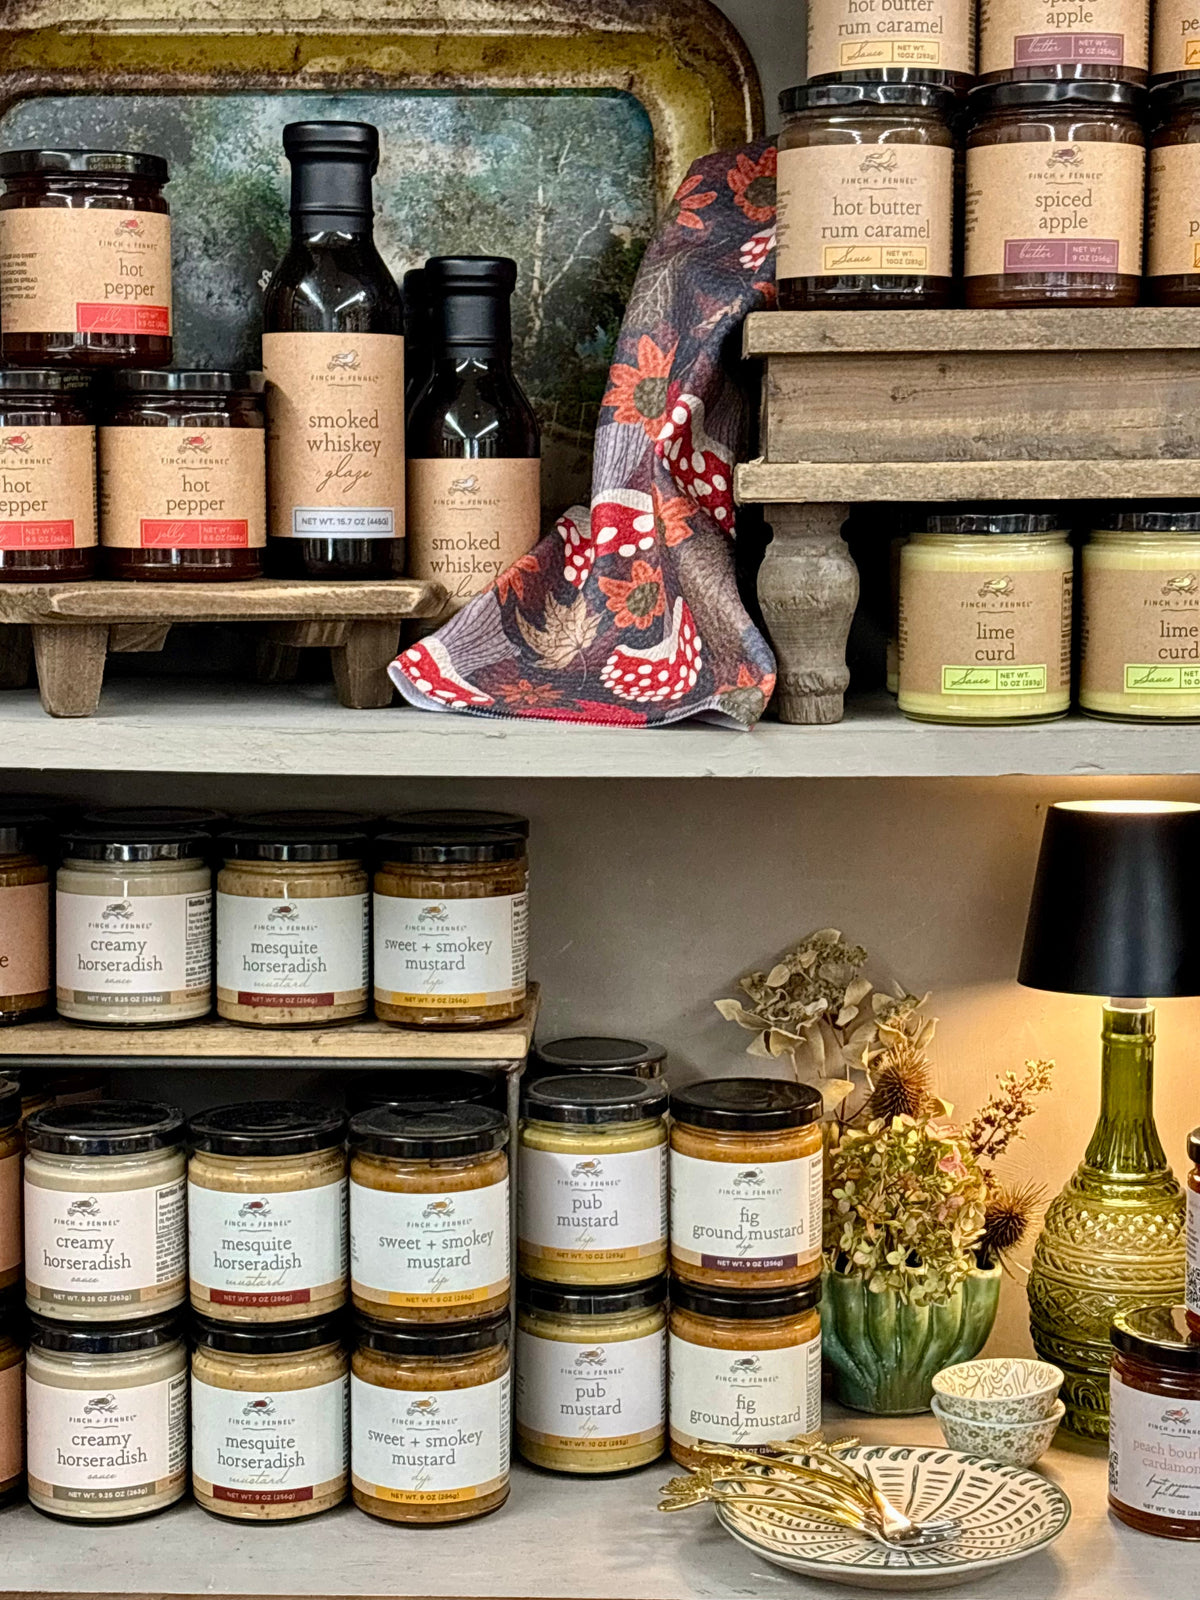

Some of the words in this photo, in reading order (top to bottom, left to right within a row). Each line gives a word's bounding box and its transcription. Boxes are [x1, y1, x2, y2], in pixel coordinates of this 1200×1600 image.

[848, 0, 875, 13] hot
[838, 21, 871, 36] rum
[877, 16, 944, 34] caramel
[1046, 6, 1093, 28] apple
[841, 177, 869, 185] FINCH
[832, 195, 862, 216] hot
[869, 195, 922, 215] butter
[1035, 189, 1093, 211] spiced
[821, 226, 858, 239] rum
[864, 219, 930, 239] caramel
[1039, 210, 1088, 233] apple
[119, 258, 144, 277] hot
[104, 282, 155, 300] pepper
[308, 409, 380, 429] smoked
[306, 432, 382, 457] whiskey
[161, 457, 187, 465] FINCH
[315, 453, 372, 493] glaze
[2, 475, 32, 493] hot
[182, 474, 210, 492] hot
[0, 499, 48, 517] epper
[166, 499, 225, 516] pepper
[301, 517, 317, 526] NET
[319, 517, 335, 526] WT.
[337, 517, 352, 525] 15.7
[355, 517, 366, 525] OZ
[432, 531, 500, 550] smoked
[430, 554, 503, 577] whiskey
[976, 622, 1015, 640] lime
[1160, 620, 1198, 638] lime
[975, 643, 1016, 661] curd
[1158, 641, 1200, 659] curd
[1017, 671, 1030, 679] WT.
[90, 938, 147, 954] creamy
[251, 941, 318, 958] mesquite
[384, 939, 417, 953] sweet
[422, 943, 431, 951] +
[436, 936, 493, 955] smokey
[77, 954, 162, 972] horseradish
[243, 955, 327, 973] horseradish
[405, 955, 465, 970] mustard
[572, 1193, 602, 1213] pub
[54, 1218, 75, 1226] FINCH
[556, 1210, 619, 1228] mustard
[740, 1207, 760, 1227] fig
[692, 1224, 743, 1241] ground
[748, 1219, 804, 1240] mustard
[56, 1236, 114, 1253] creamy
[221, 1237, 292, 1255] mesquite
[378, 1236, 421, 1250] sweet
[427, 1241, 436, 1250] +
[442, 1229, 494, 1249] smokey
[43, 1249, 131, 1270] horseradish
[213, 1251, 302, 1271] horseradish
[407, 1249, 471, 1269] mustard
[225, 1269, 287, 1287] mustard
[575, 1382, 606, 1401] pub
[560, 1398, 622, 1416] mustard
[736, 1393, 756, 1413] fig
[69, 1416, 92, 1424] FINCH
[689, 1410, 740, 1428] ground
[744, 1406, 801, 1427] mustard
[71, 1433, 132, 1449] creamy
[225, 1435, 296, 1454] mesquite
[368, 1429, 405, 1447] sweet
[410, 1438, 420, 1447] +
[426, 1429, 483, 1448] smokey
[1133, 1439, 1165, 1455] peach
[56, 1447, 148, 1468] horseradish
[217, 1448, 305, 1469] horseradish
[392, 1448, 456, 1466] mustard
[229, 1466, 291, 1485] mustard
